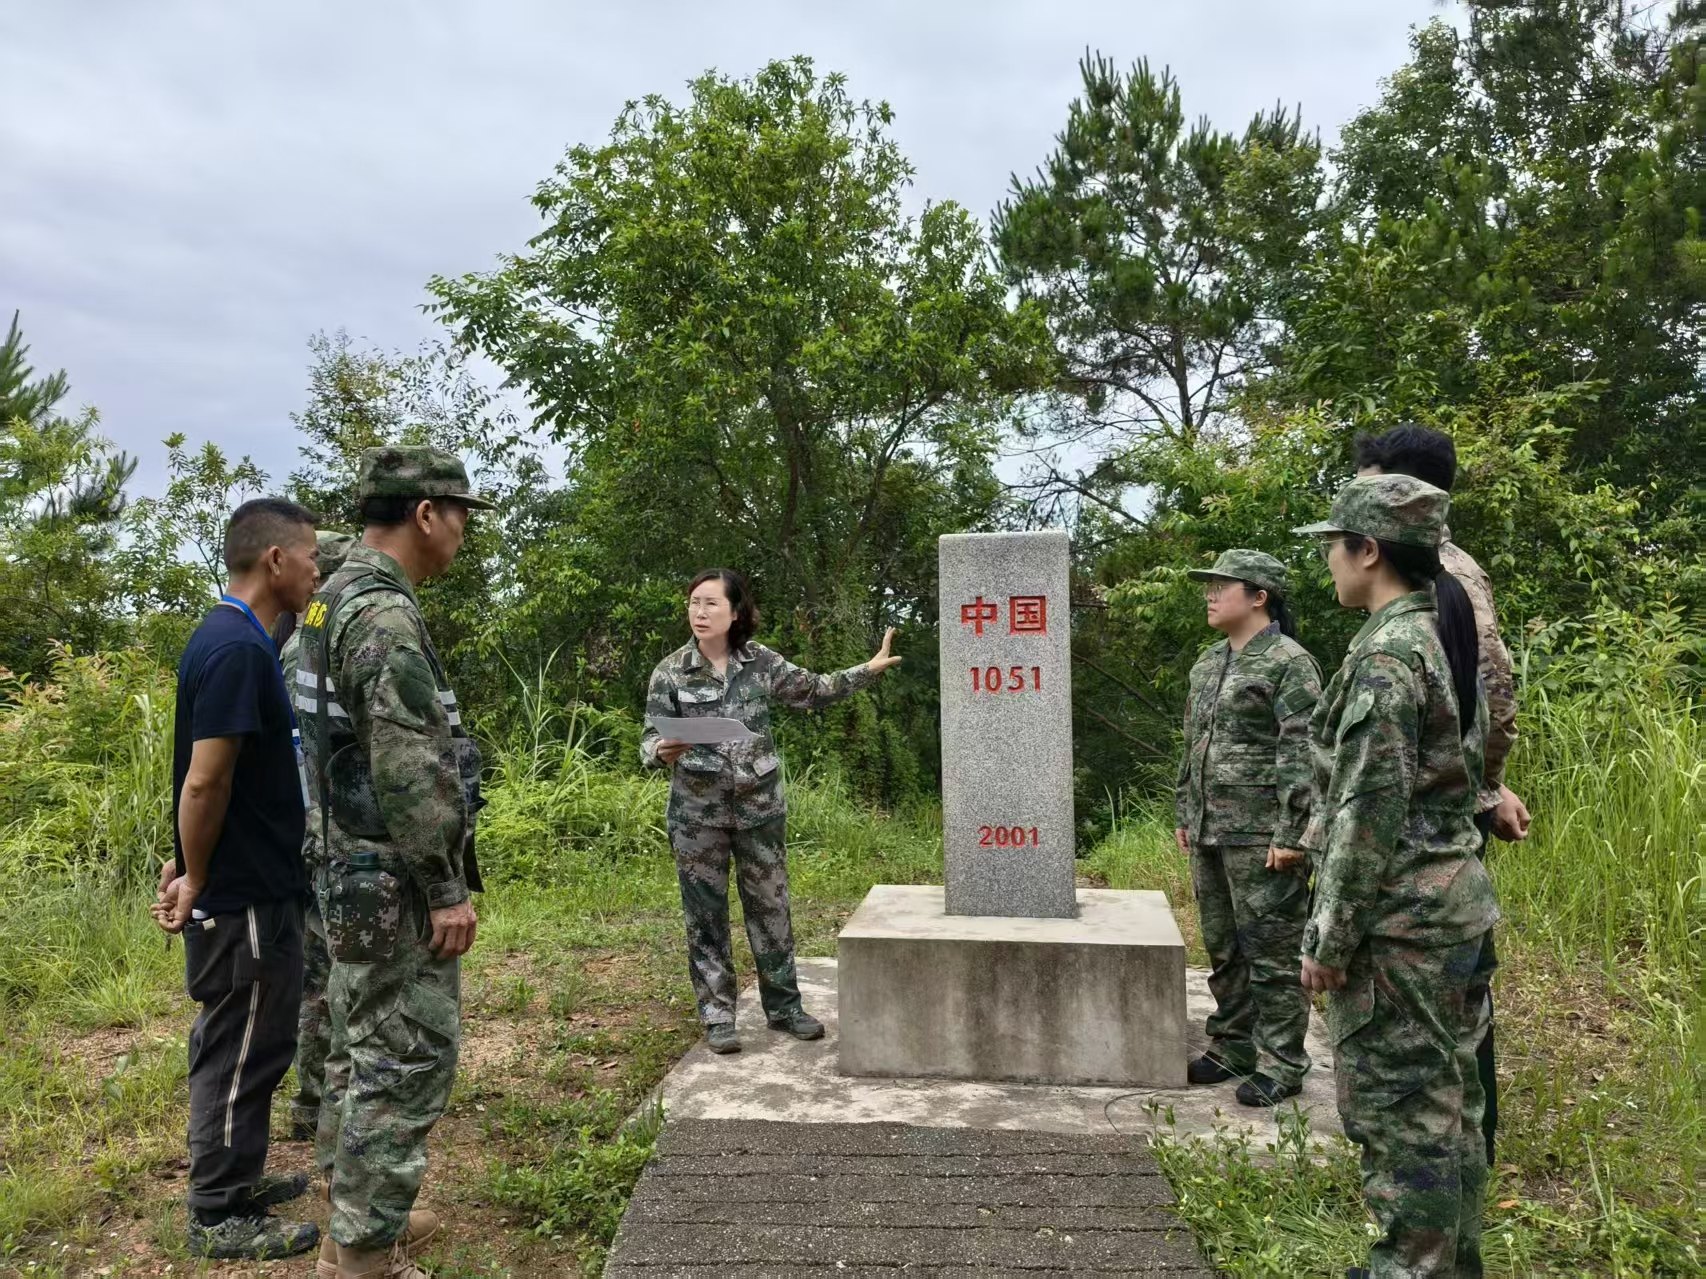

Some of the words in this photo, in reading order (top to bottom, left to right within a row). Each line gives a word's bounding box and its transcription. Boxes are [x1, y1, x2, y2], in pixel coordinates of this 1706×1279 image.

[961, 595, 1047, 636] 中国
[969, 666, 1041, 692] 1051
[978, 826, 1039, 848] 2001
